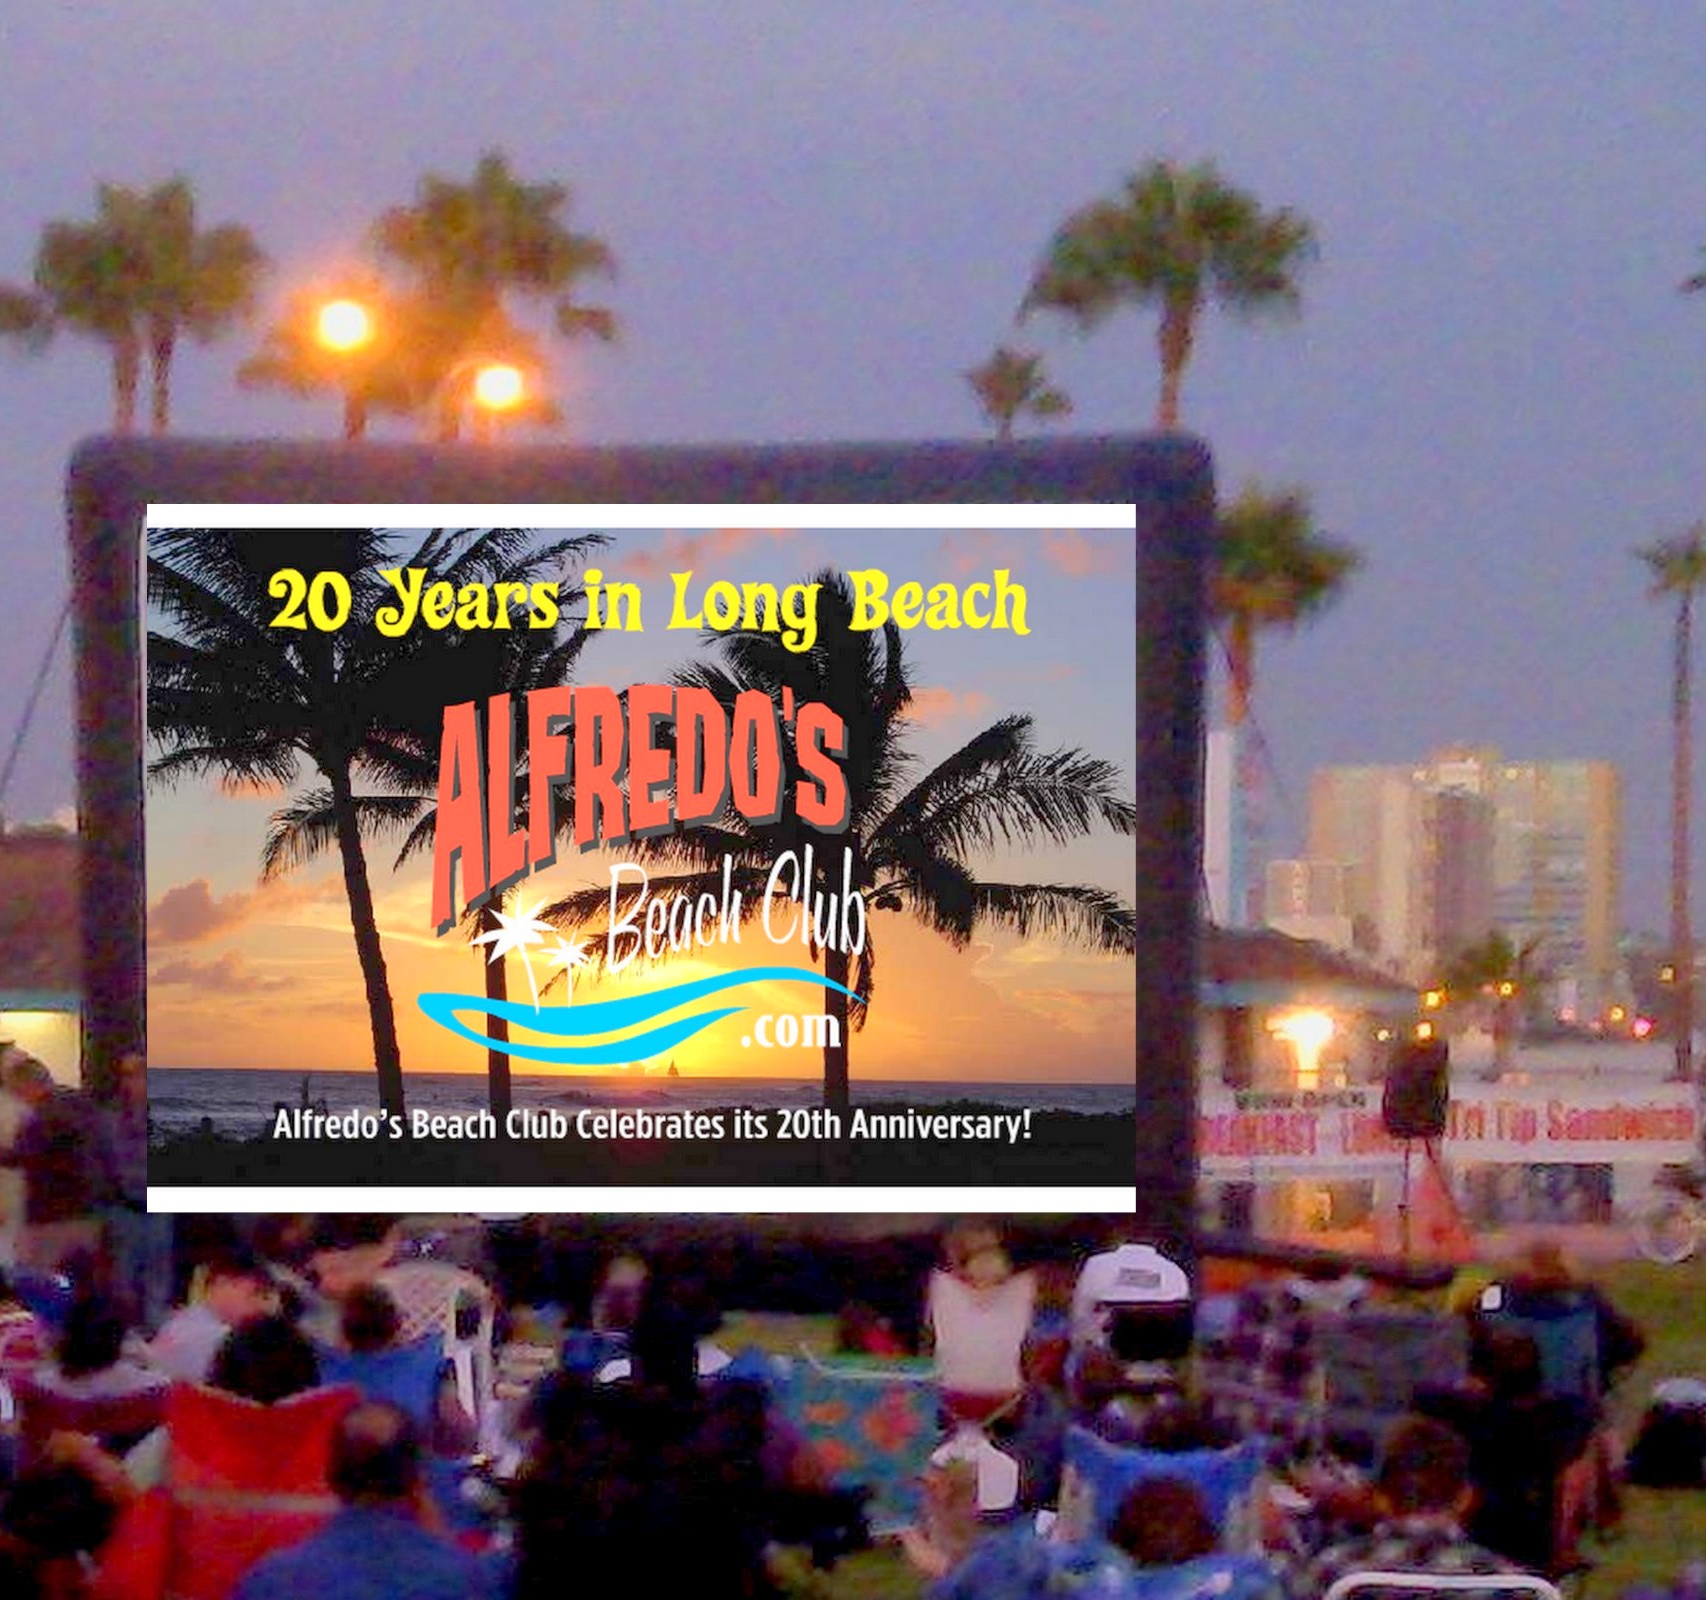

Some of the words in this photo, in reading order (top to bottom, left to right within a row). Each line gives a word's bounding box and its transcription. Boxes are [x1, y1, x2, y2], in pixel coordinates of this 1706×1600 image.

[268, 569, 352, 631] 20
[375, 567, 559, 637] Years
[583, 568, 644, 632] in
[668, 570, 822, 653] Long
[848, 568, 1031, 636] Beach
[430, 684, 849, 935] ALFREDO'S
[606, 853, 743, 975] Beach
[762, 843, 866, 956] Club
[741, 1014, 841, 1047] .com
[273, 1107, 403, 1140] Alfredo's
[411, 1107, 496, 1140] Beach
[506, 1107, 568, 1140] Club
[576, 1107, 725, 1140] Celebrates
[734, 1107, 768, 1140] its
[776, 1107, 841, 1140] 20th
[849, 1107, 1032, 1145] Anniversary!
